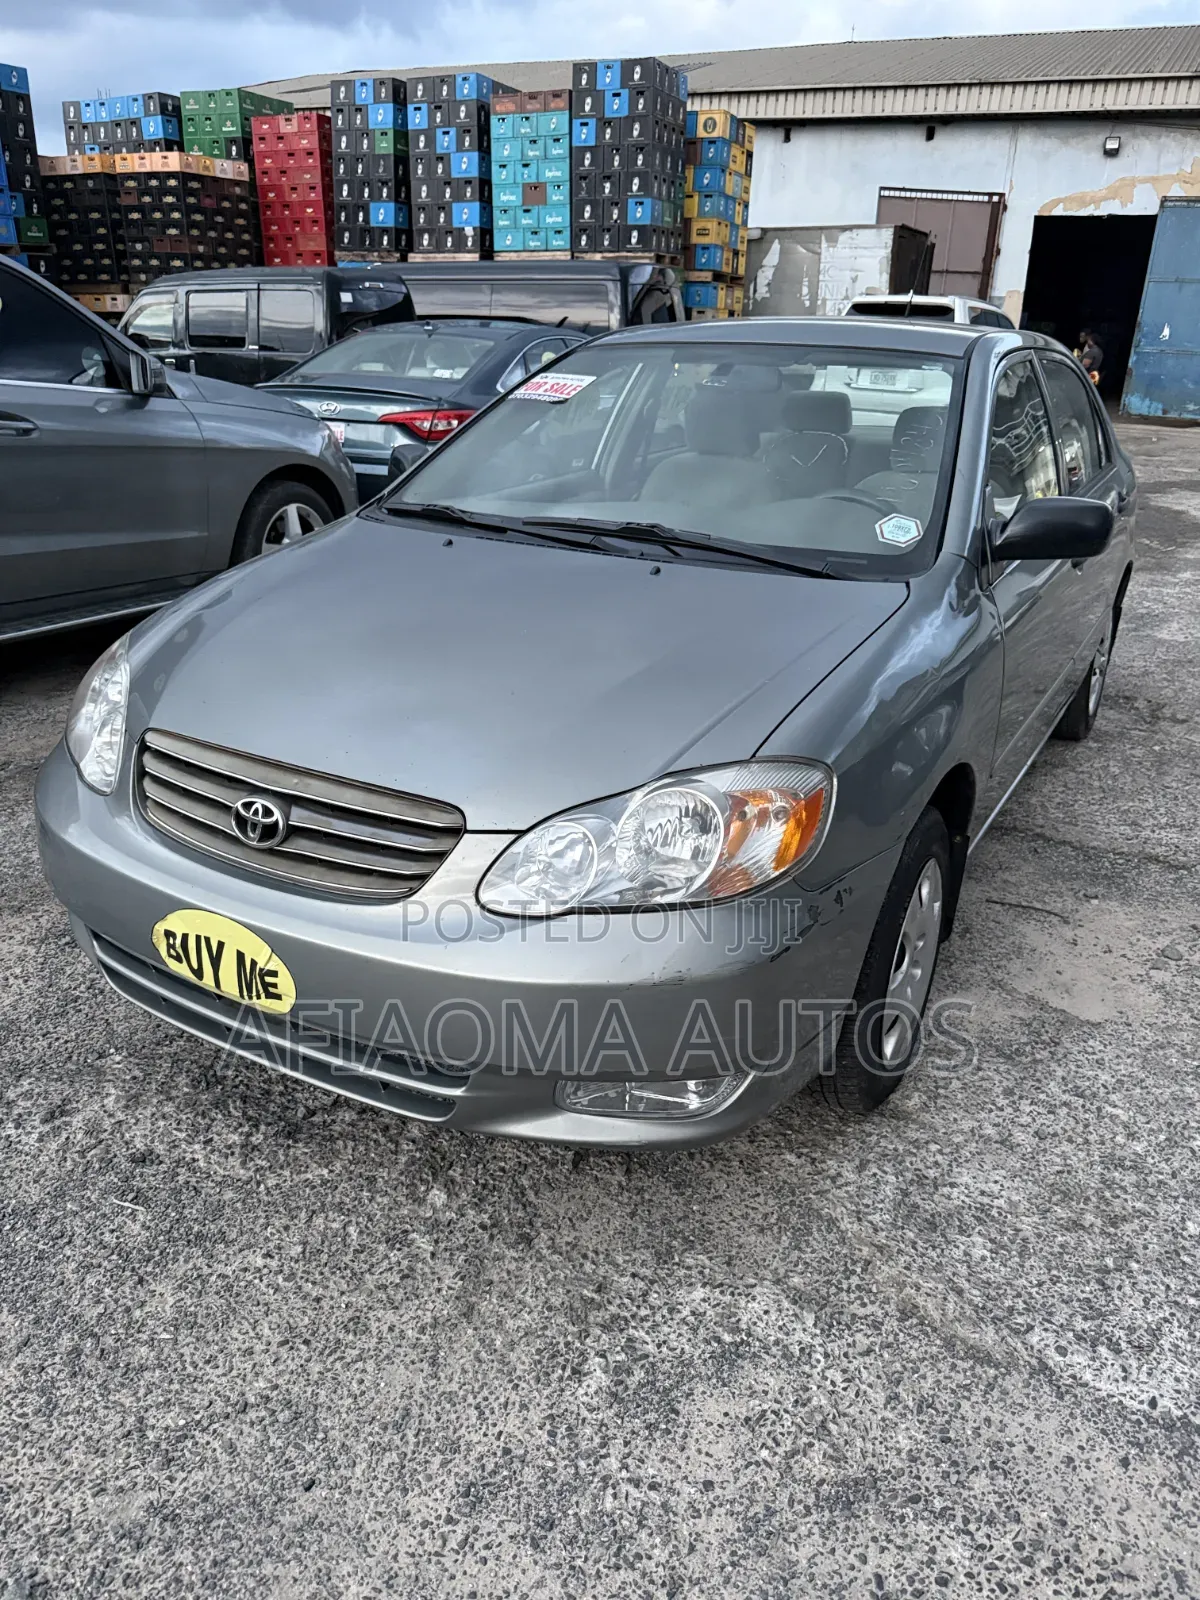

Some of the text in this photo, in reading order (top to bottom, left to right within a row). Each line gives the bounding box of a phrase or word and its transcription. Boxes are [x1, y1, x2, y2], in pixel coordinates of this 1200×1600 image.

[519, 381, 583, 396] FOR SALE
[163, 929, 283, 1001] BUY ME
